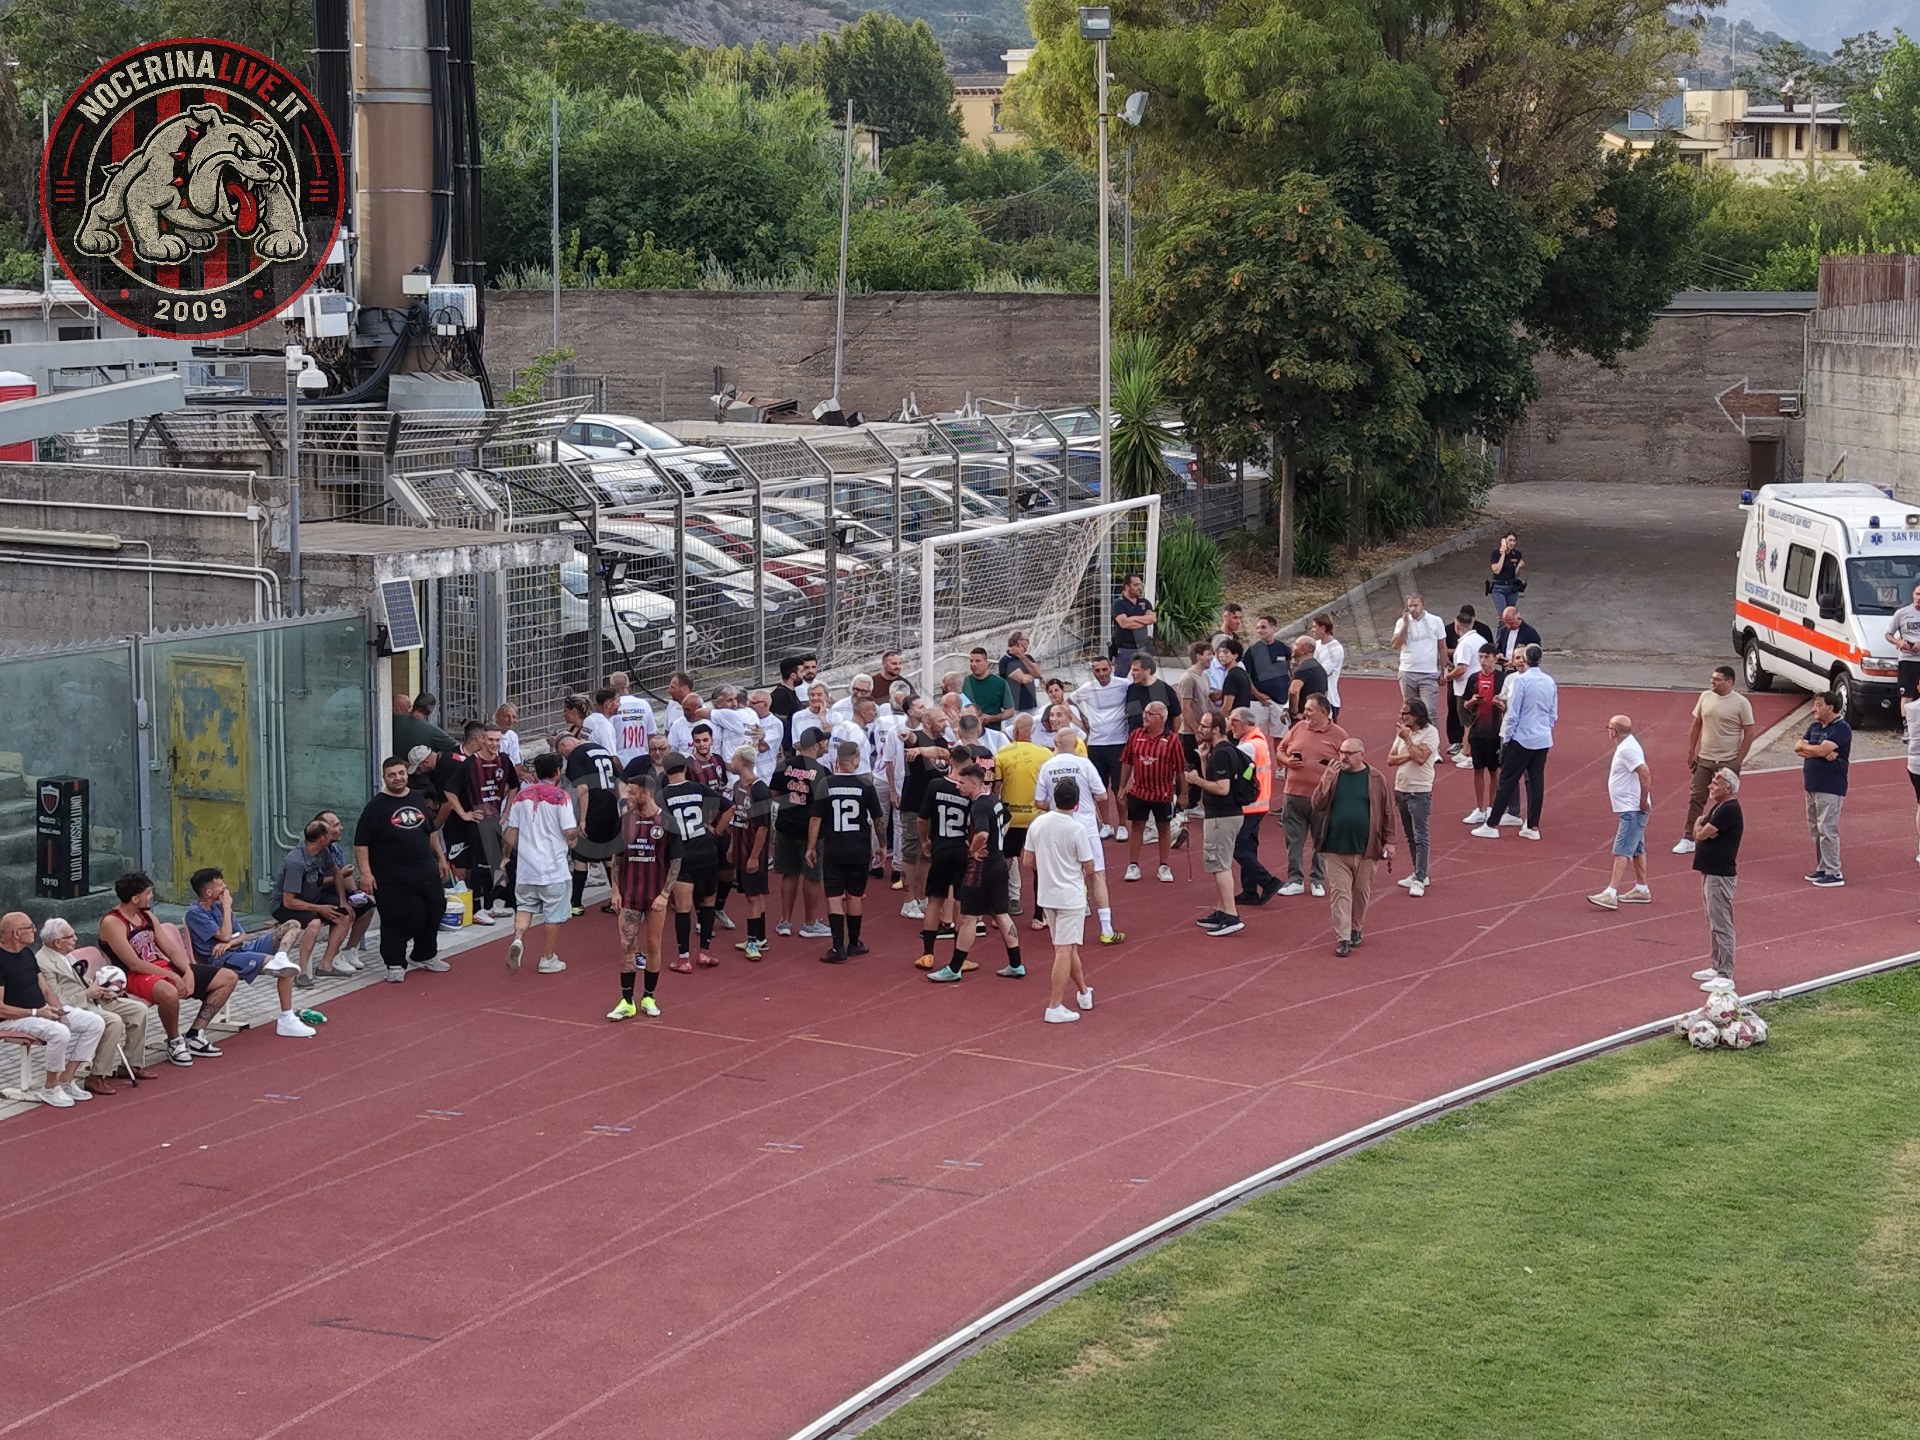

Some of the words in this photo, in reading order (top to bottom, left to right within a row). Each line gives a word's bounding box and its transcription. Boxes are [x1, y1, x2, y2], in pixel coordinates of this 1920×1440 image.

[1891, 532, 1907, 541] SAN
[622, 725, 645, 749] 1910
[594, 758, 615, 790] 12
[673, 806, 706, 841] 12
[831, 799, 860, 832] 12
[938, 804, 965, 838] 12
